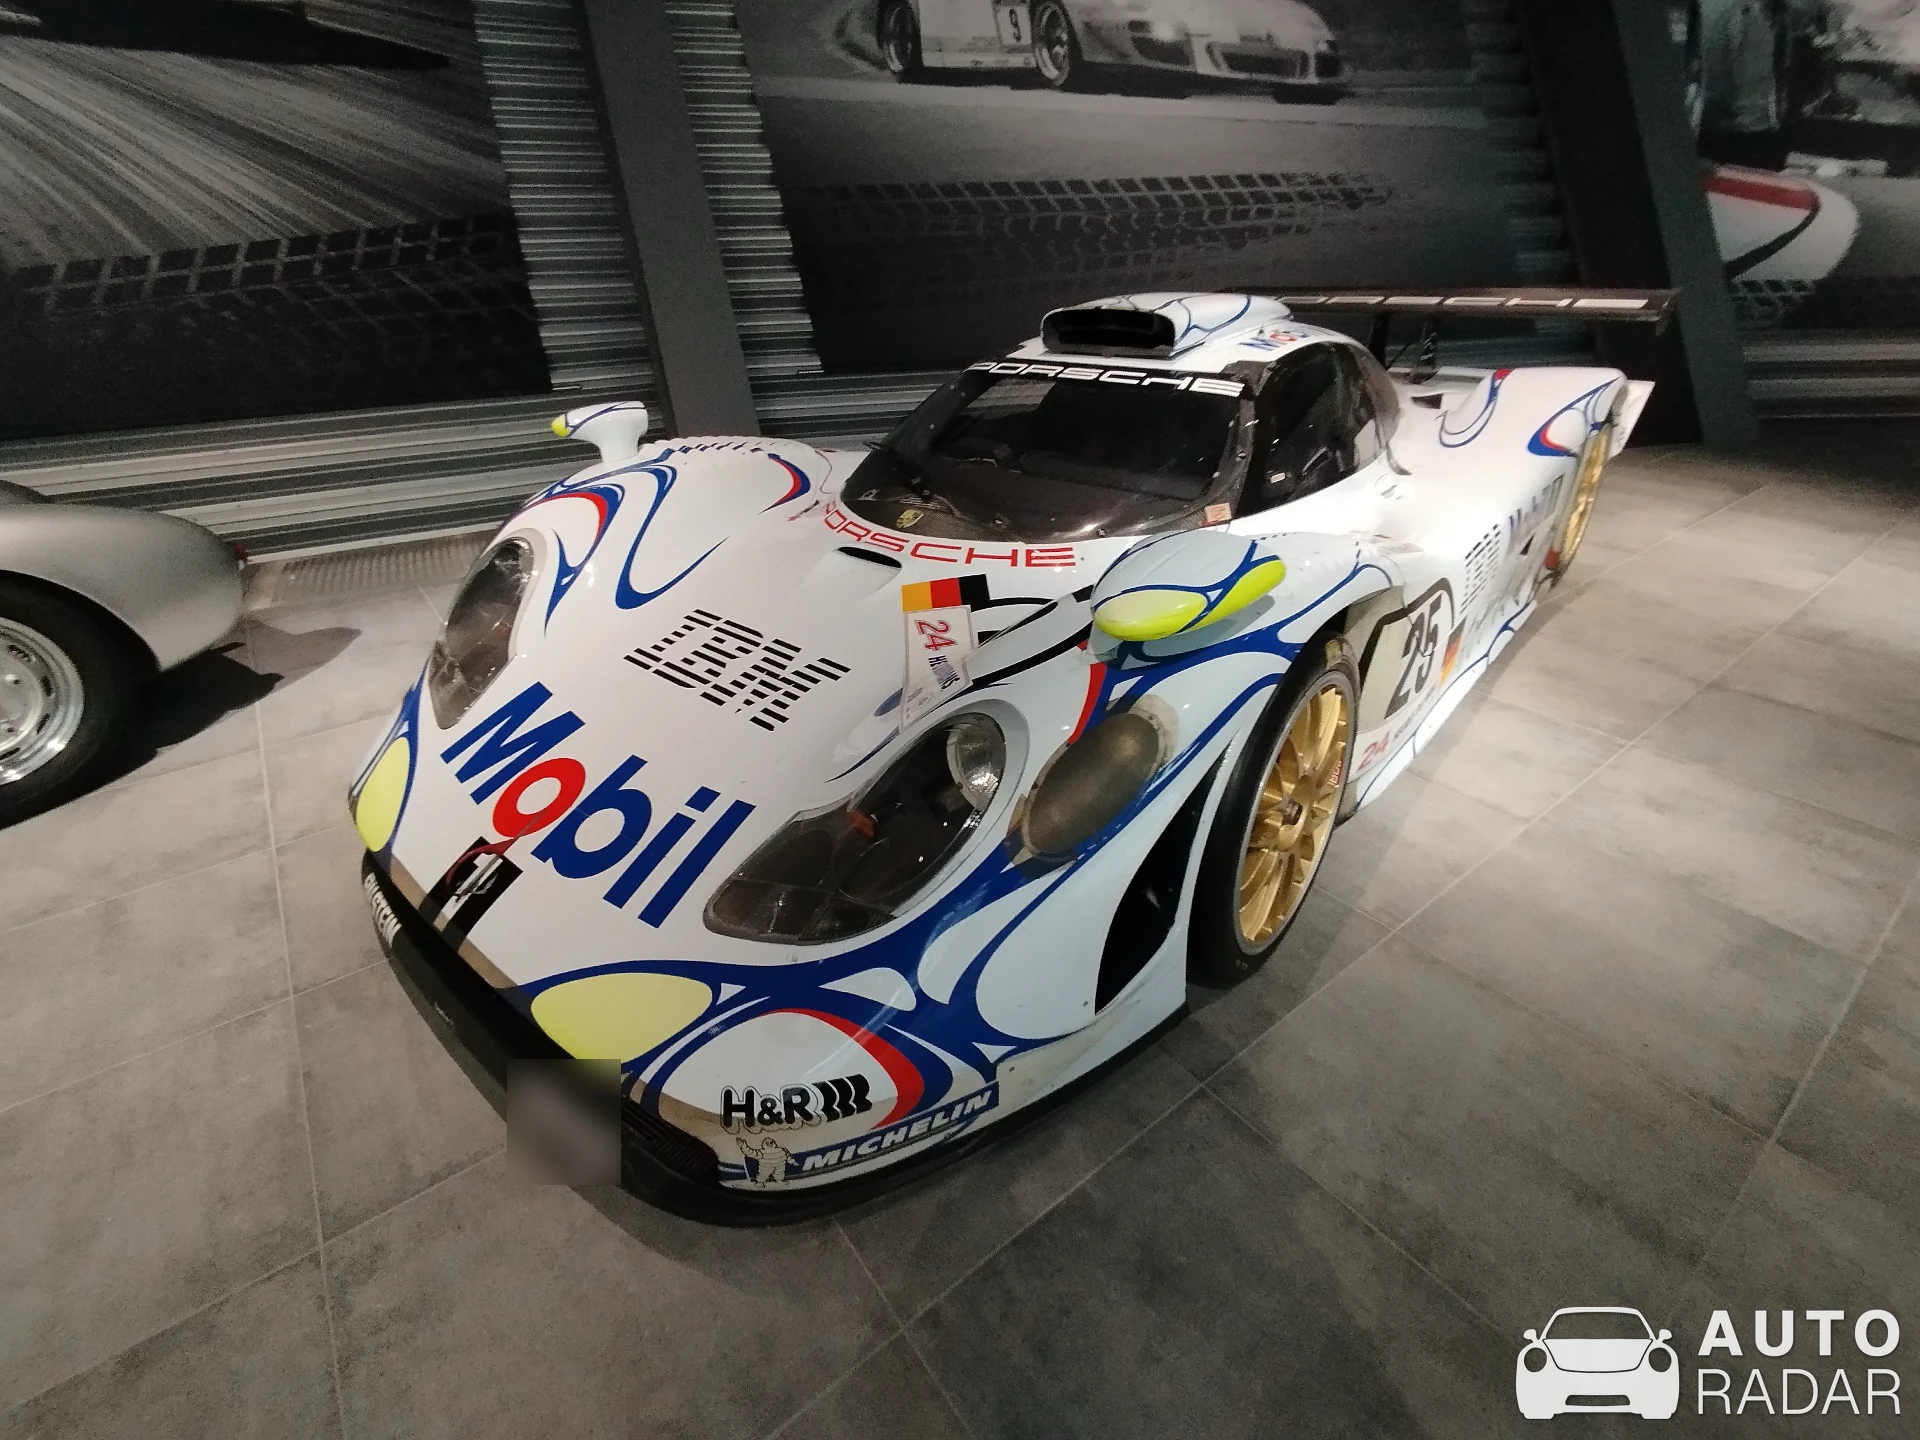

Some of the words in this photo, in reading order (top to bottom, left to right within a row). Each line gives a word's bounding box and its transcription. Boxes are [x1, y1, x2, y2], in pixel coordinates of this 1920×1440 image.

[962, 362, 1246, 397] PORSCHE
[823, 500, 1077, 568] PORSCHE
[916, 619, 957, 651] 24
[1384, 592, 1443, 720] 25
[622, 608, 852, 732] IBM
[1356, 729, 1391, 772] 24
[441, 681, 757, 929] Mobil
[721, 1085, 818, 1129] H&R
[802, 1089, 993, 1172] MICHELIN
